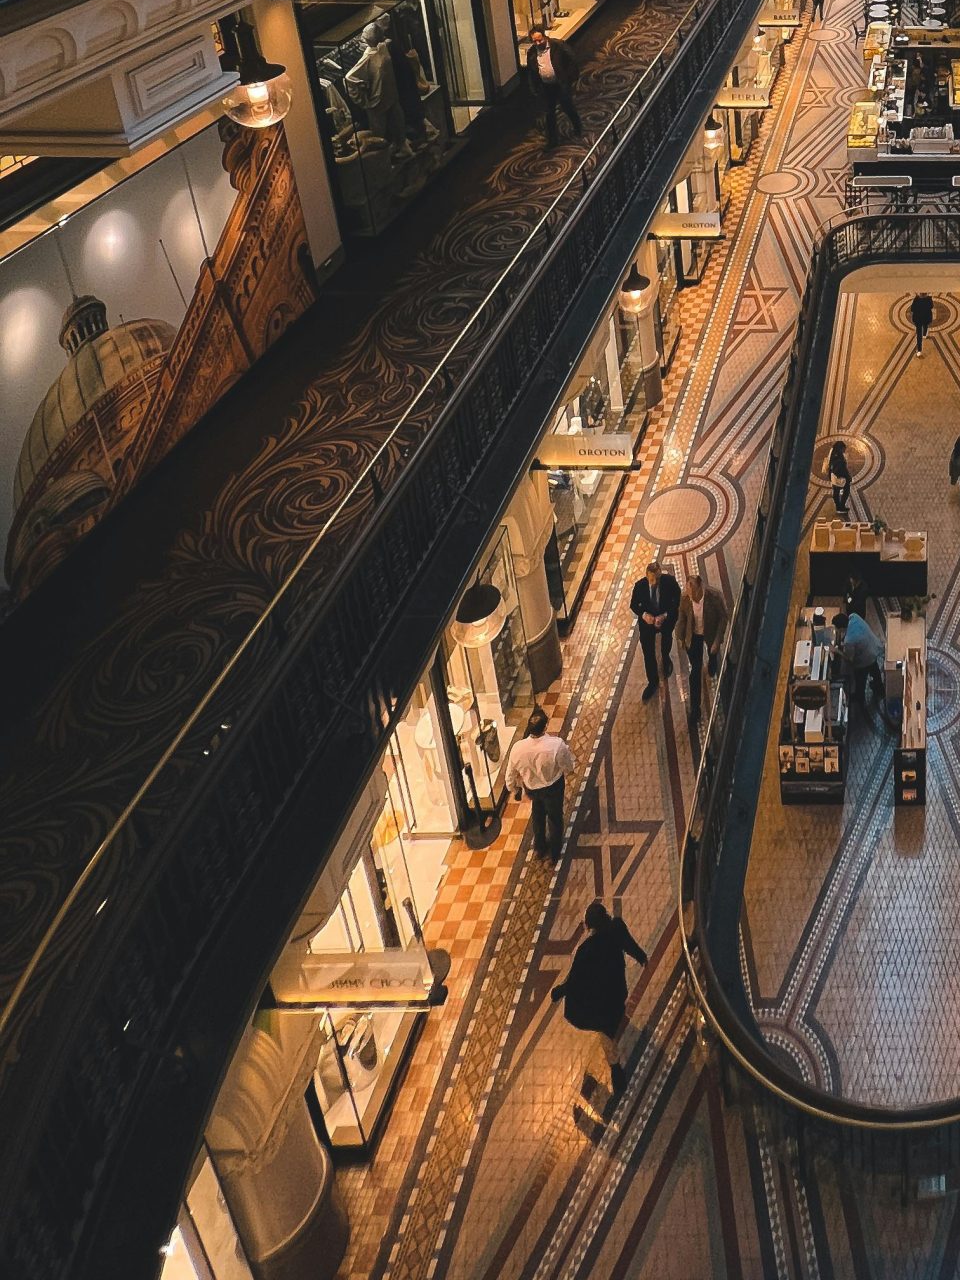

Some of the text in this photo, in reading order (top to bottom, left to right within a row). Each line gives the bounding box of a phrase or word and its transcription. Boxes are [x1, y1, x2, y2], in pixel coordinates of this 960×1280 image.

[731, 93, 765, 101] FURLA
[578, 448, 626, 456] OROTON
[328, 978, 366, 990] JIMMY
